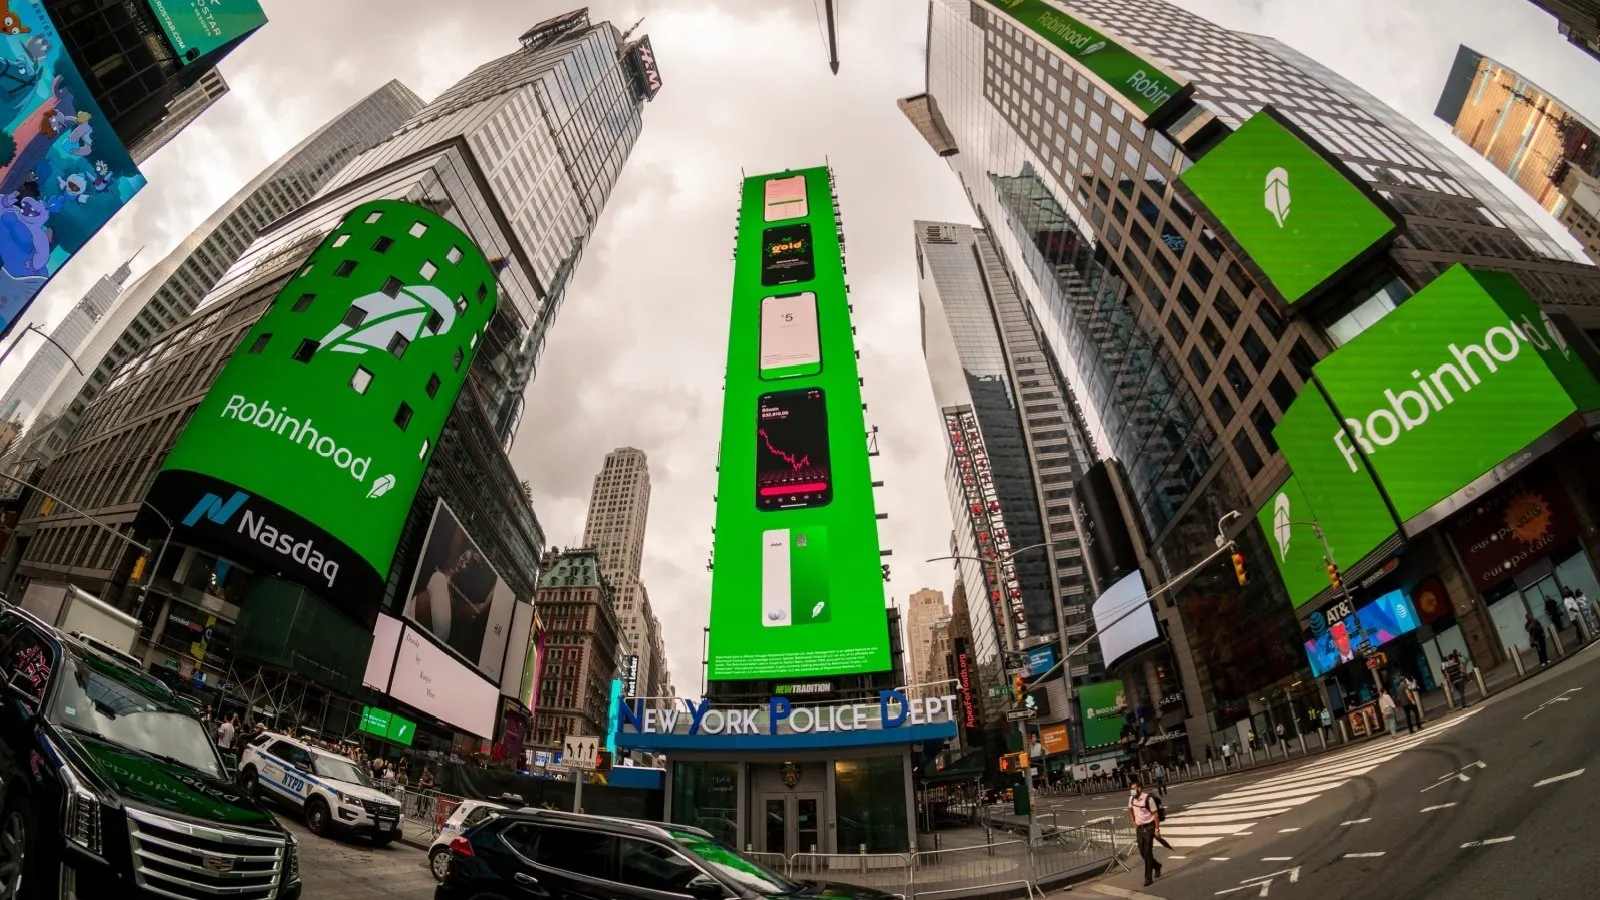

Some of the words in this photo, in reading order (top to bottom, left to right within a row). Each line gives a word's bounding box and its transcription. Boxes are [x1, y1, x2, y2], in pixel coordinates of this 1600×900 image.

[154, 0, 186, 49] ROSTAR.COM
[1037, 11, 1090, 50] Robinhood
[772, 241, 802, 254] gold
[220, 395, 372, 482] Robinhood
[237, 510, 340, 588] Nasdaq
[629, 656, 638, 680] Locker
[960, 653, 974, 728] ApexForYouth.org
[281, 772, 305, 792] NYPD
